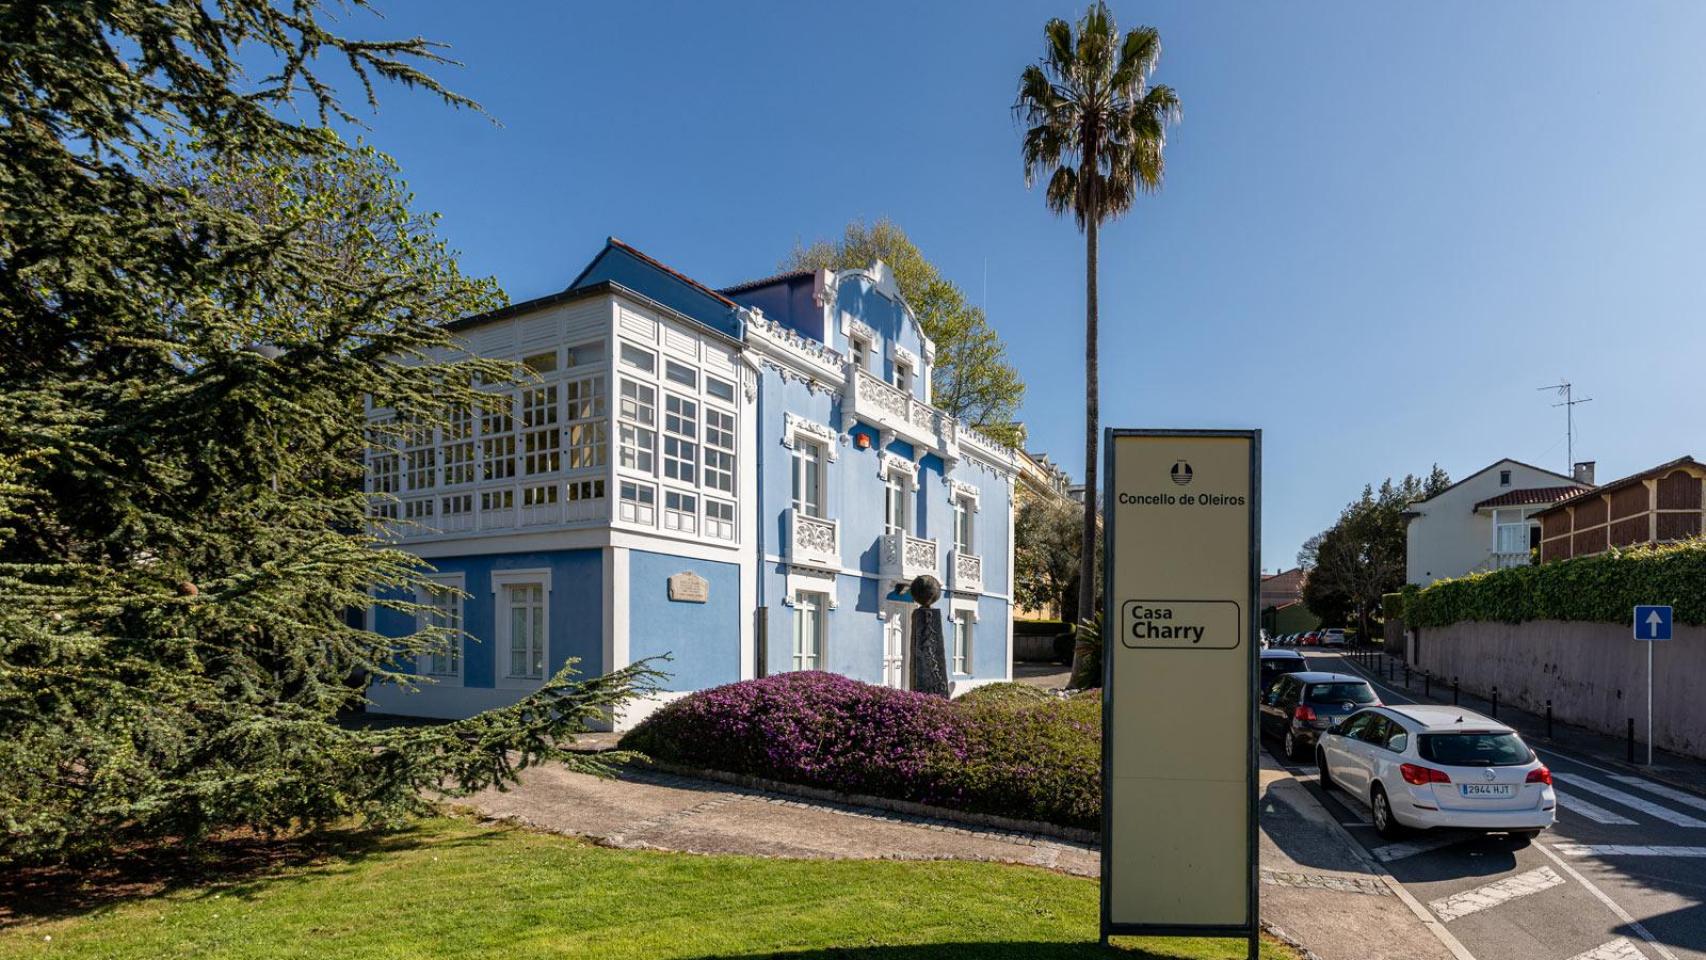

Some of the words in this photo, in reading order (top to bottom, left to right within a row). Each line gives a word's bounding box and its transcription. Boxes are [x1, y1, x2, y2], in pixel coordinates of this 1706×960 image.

[1119, 493, 1176, 505] Concello
[1179, 493, 1195, 505] de
[1198, 494, 1245, 505] Oleiros
[1132, 606, 1172, 619] Casa
[1132, 621, 1204, 643] Charry
